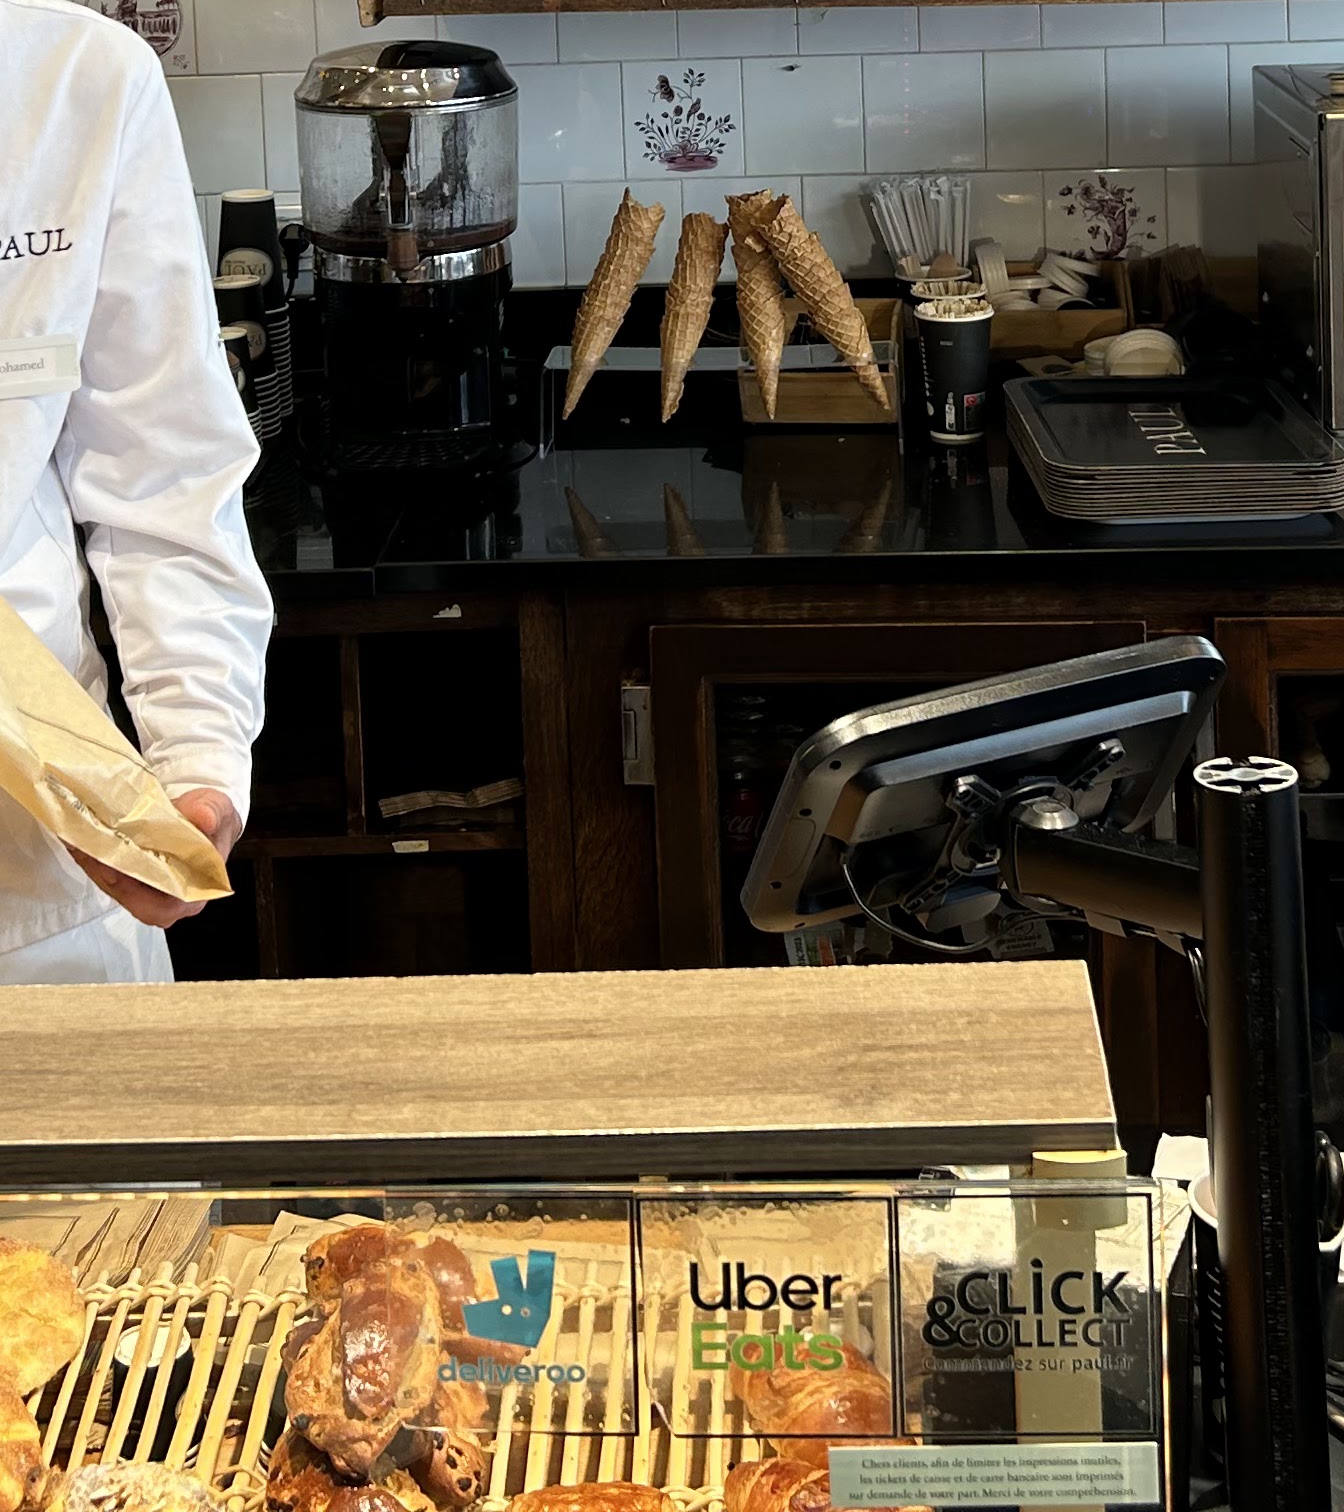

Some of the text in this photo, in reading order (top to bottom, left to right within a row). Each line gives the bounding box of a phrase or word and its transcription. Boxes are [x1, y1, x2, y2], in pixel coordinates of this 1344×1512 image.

[689, 1260, 843, 1312] Uber
[690, 1321, 845, 1372] Eats
[1039, 1357, 1066, 1370] sur
[436, 1355, 586, 1384] deliveroo
